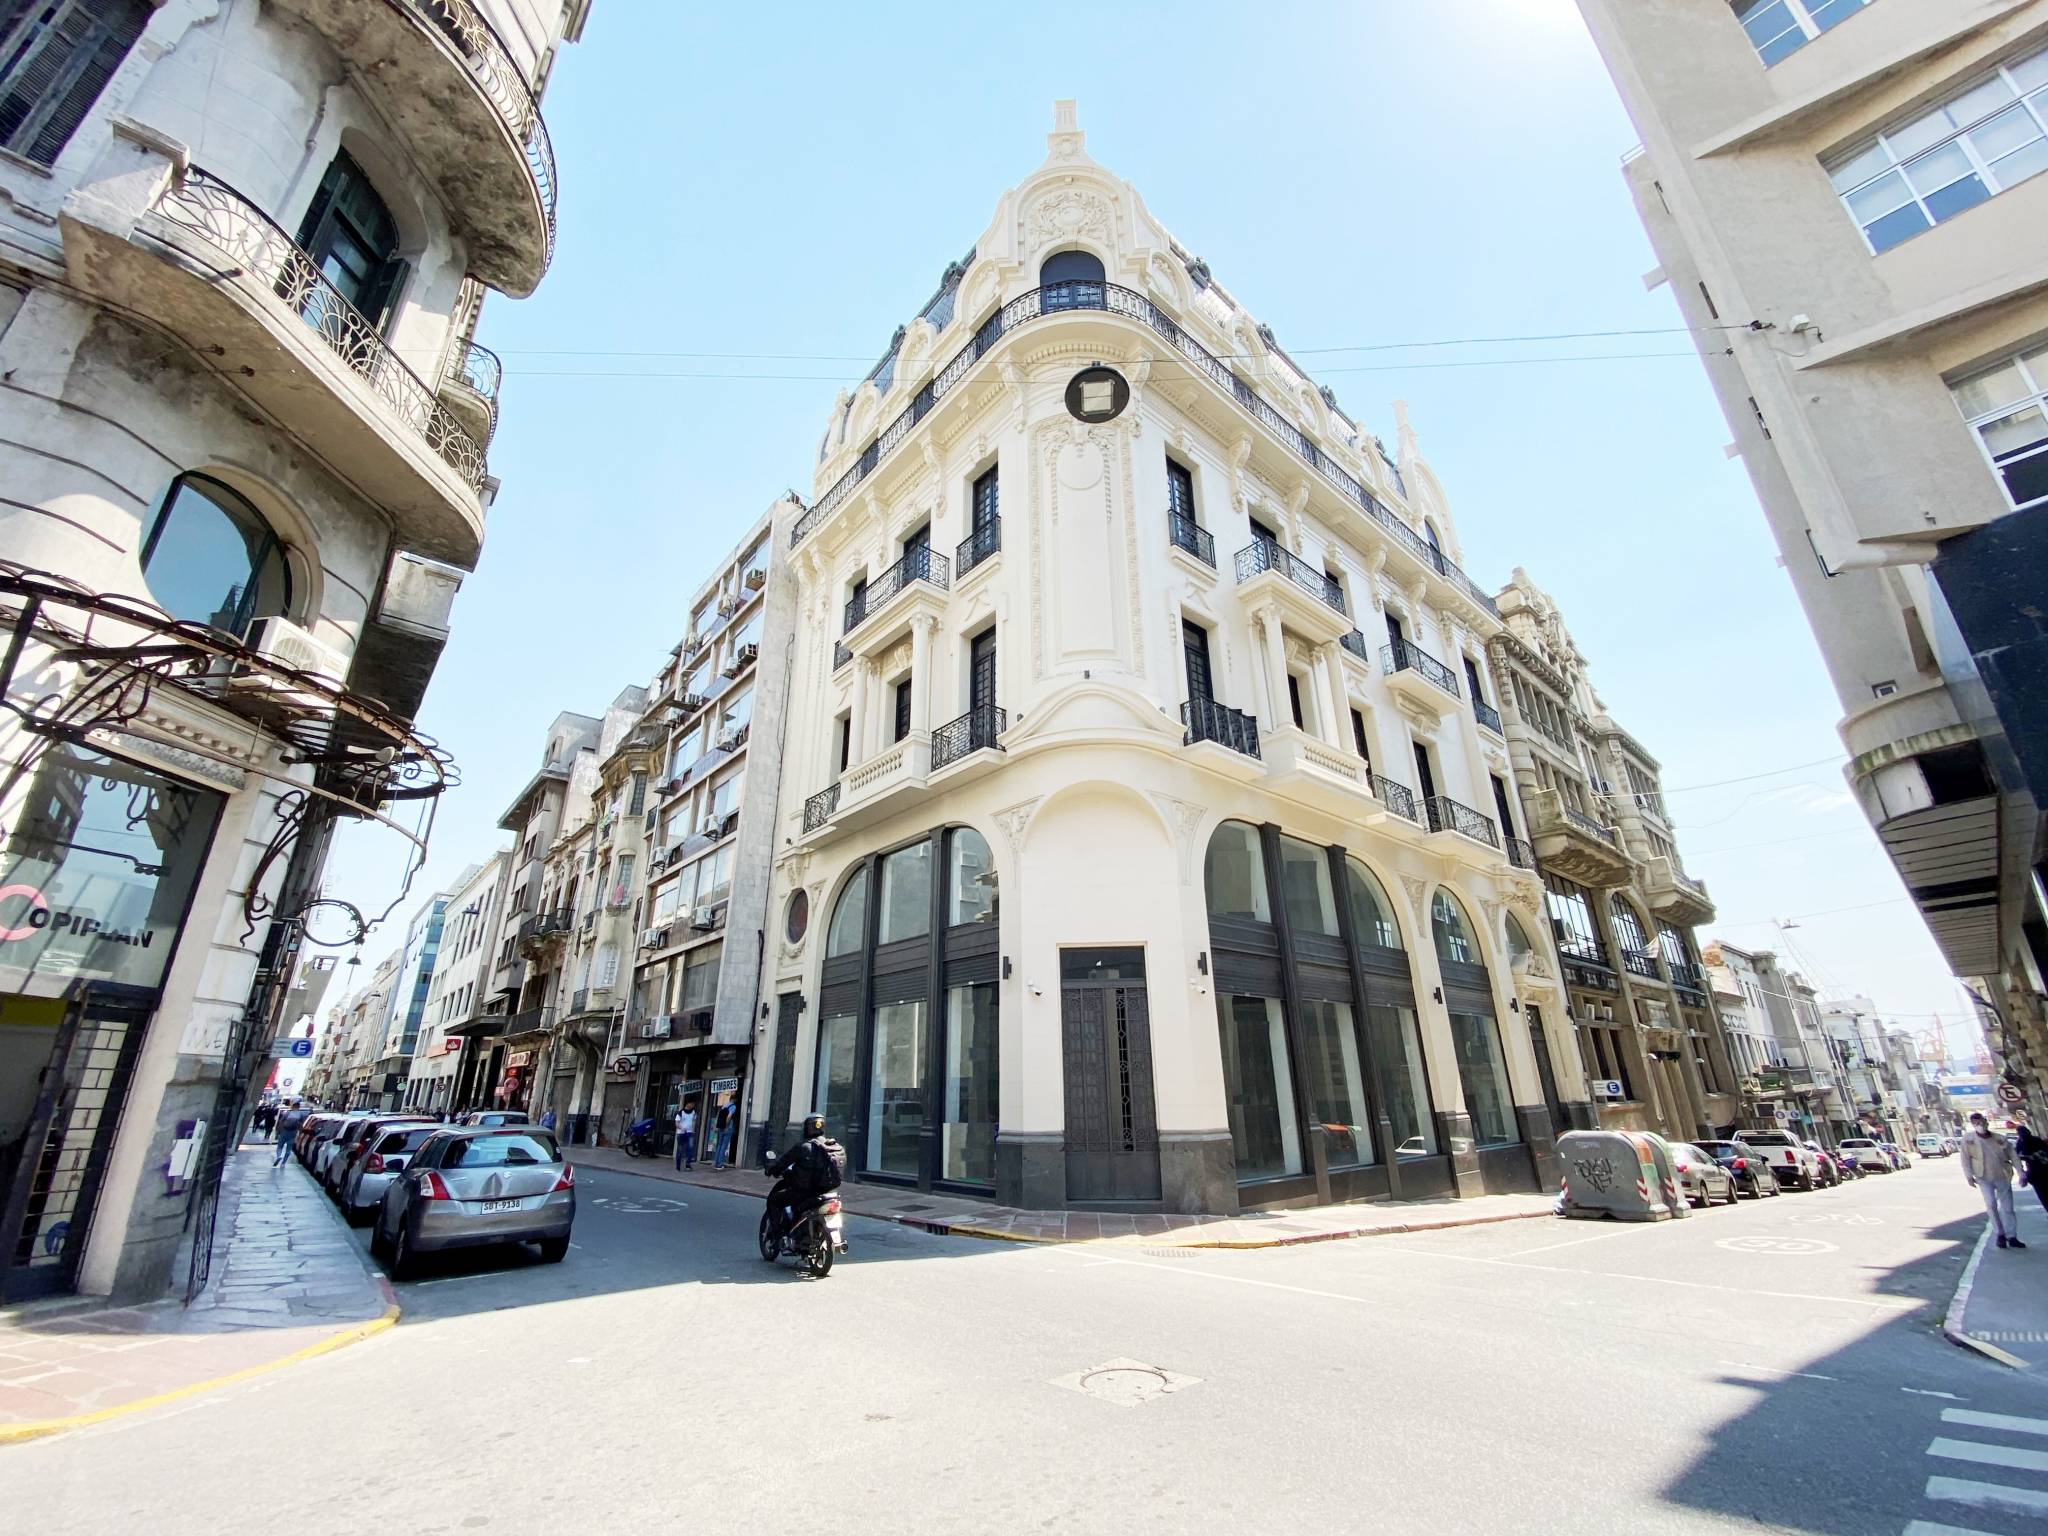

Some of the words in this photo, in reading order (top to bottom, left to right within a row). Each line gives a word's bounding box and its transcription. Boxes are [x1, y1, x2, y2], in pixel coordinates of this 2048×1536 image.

[296, 1042, 307, 1053] E
[680, 1080, 703, 1094] TIMBRES
[713, 1080, 737, 1091] TIMBRES
